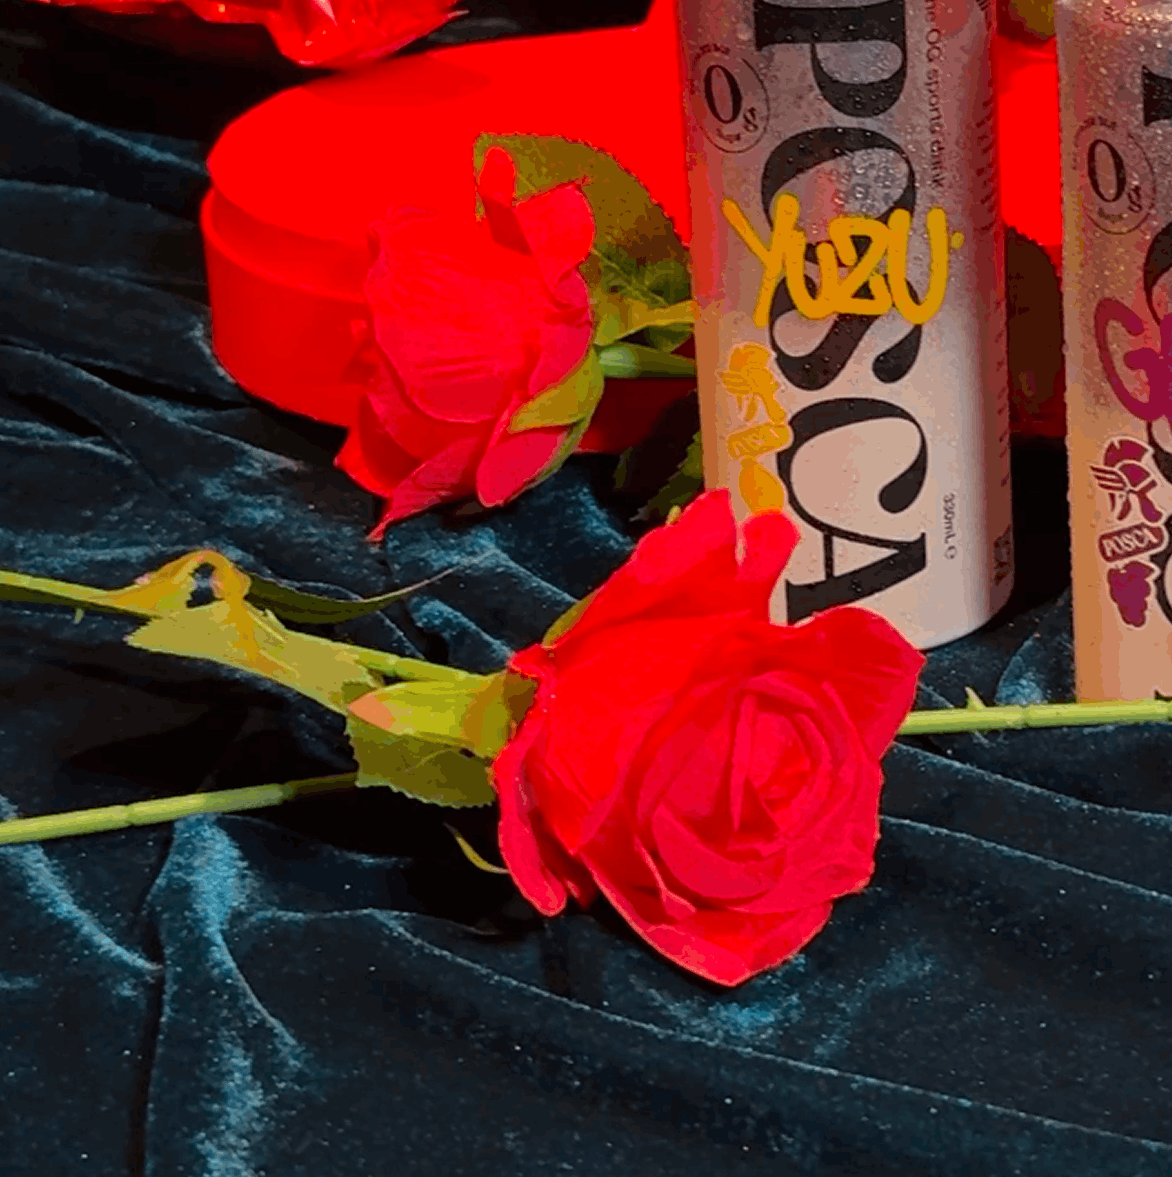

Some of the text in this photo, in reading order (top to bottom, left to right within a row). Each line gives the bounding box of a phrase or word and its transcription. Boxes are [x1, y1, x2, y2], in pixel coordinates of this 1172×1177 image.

[925, 68, 943, 134] sports
[929, 139, 945, 190] drink
[722, 193, 950, 327] YUZU
